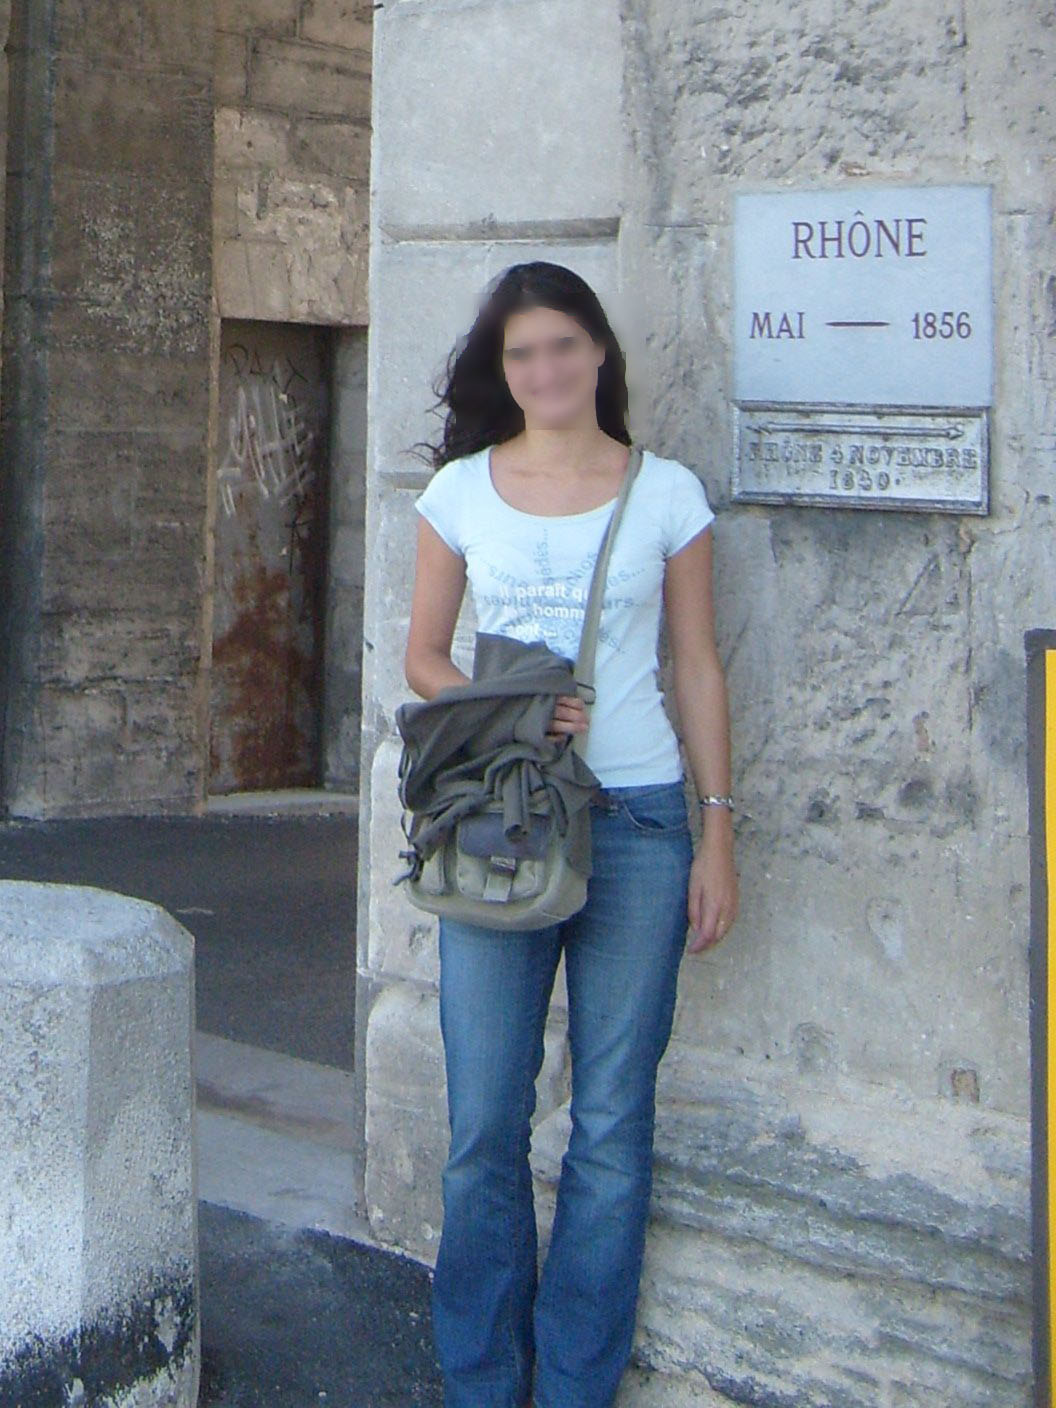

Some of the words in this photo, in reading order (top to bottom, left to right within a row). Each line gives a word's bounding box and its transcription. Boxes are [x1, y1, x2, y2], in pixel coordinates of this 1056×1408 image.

[791, 210, 927, 259] RHÔNE
[749, 312, 806, 339] MAI
[911, 312, 972, 340] 1856
[849, 445, 978, 470] NOVEMBRE
[534, 604, 586, 619] homm
